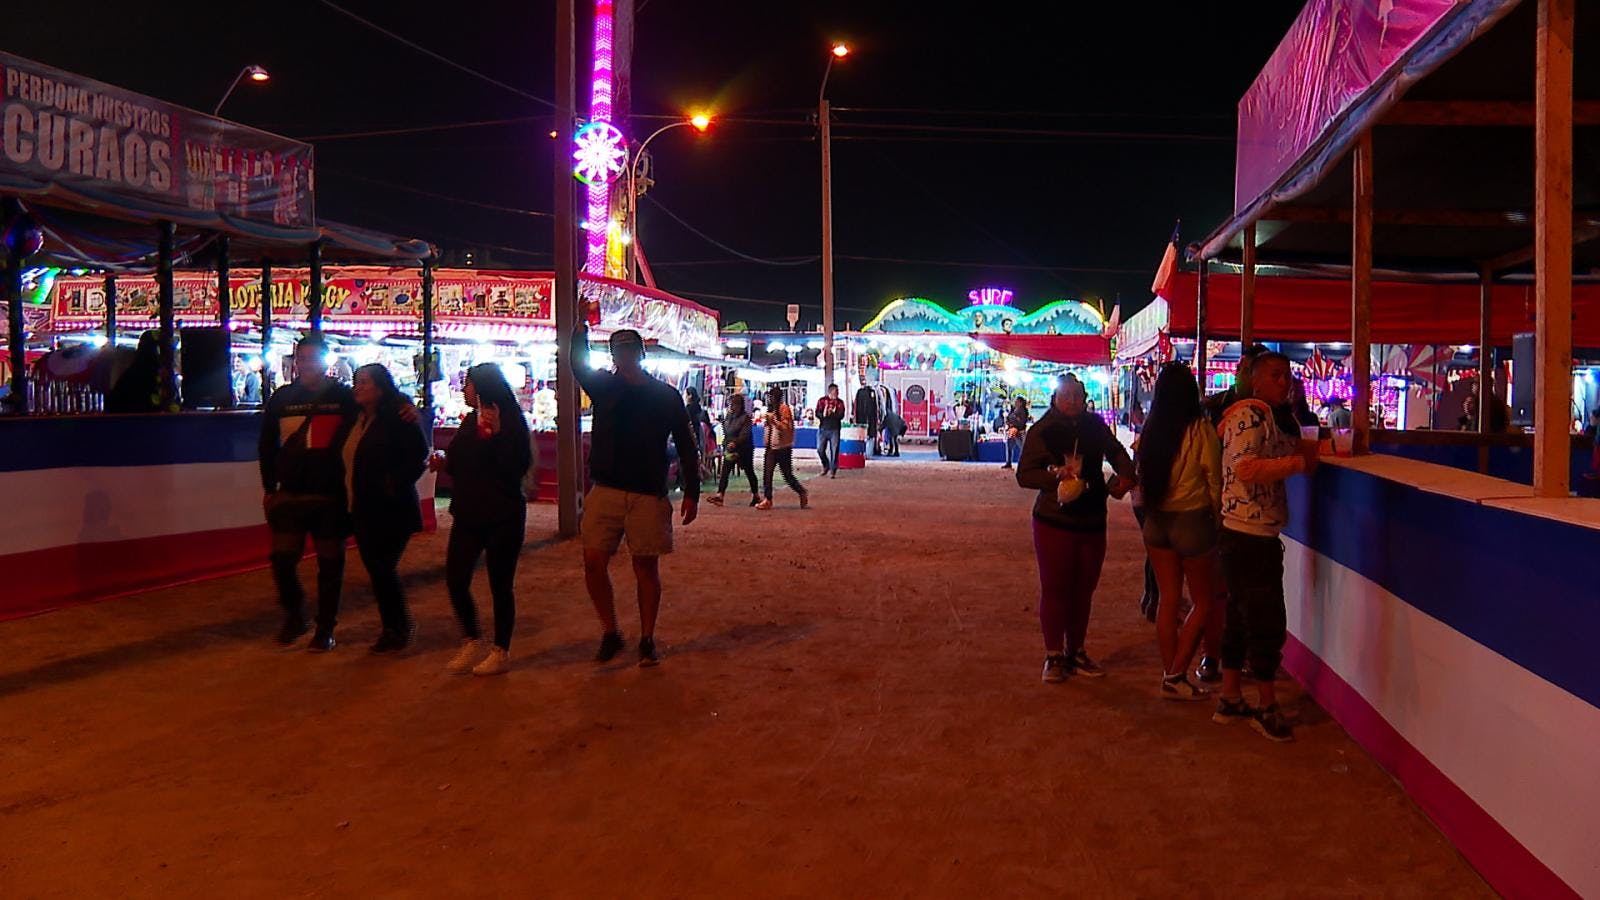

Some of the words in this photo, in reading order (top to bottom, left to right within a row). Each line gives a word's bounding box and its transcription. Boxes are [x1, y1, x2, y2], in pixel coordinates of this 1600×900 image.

[6, 67, 88, 115] PERDONA
[91, 94, 171, 138] NUESTROS
[3, 103, 171, 193] CURAOS
[968, 288, 1013, 306] SURF
